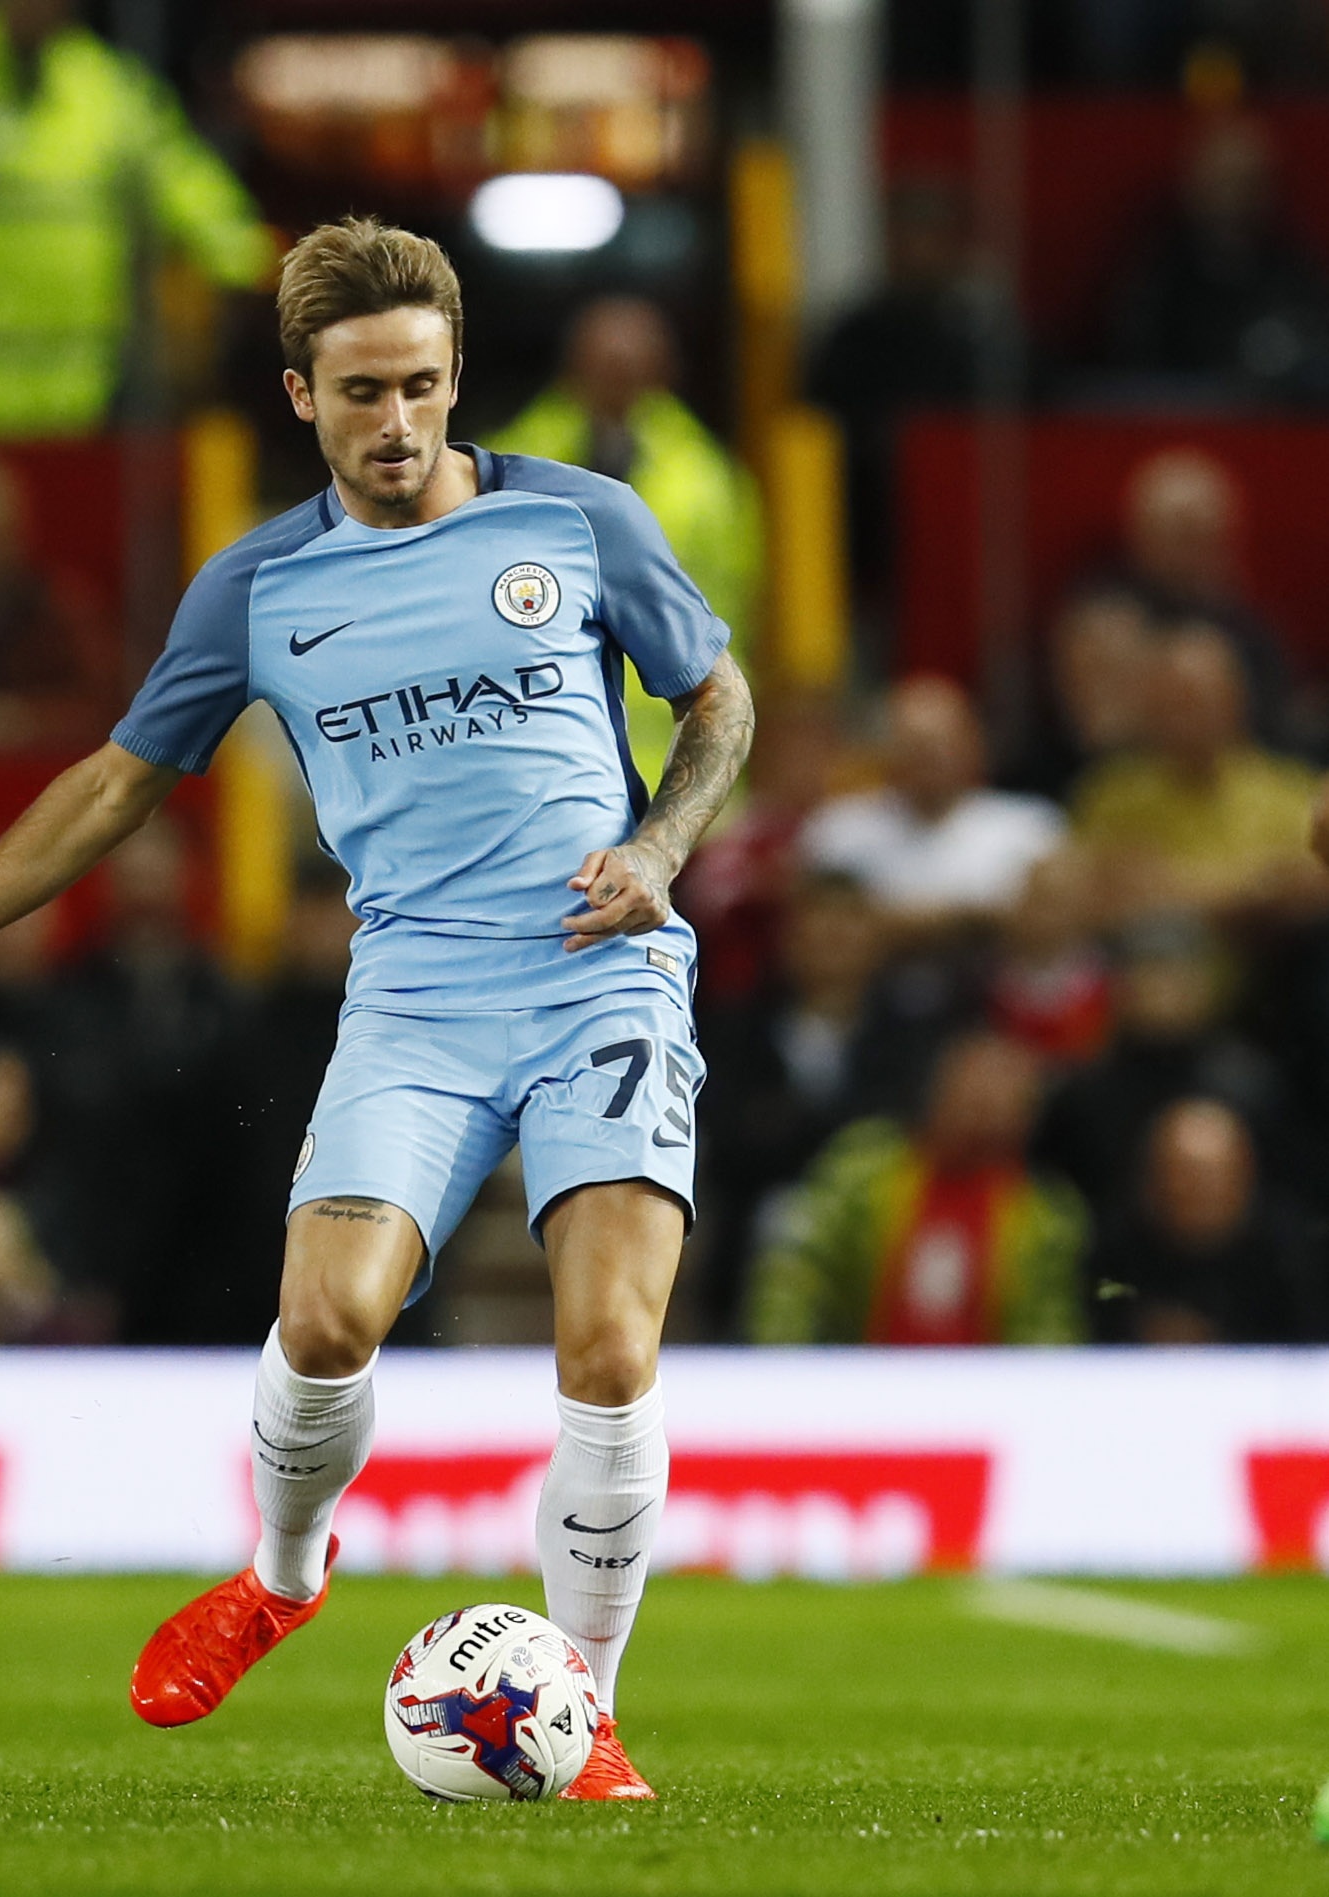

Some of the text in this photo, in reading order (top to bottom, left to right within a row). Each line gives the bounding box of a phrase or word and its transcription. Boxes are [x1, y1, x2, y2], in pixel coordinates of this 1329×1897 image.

[498, 567, 552, 590] MANCHESTER
[315, 662, 563, 743] ETIHAD
[371, 705, 528, 762] AIRWAYS
[590, 1039, 690, 1141] 75
[449, 1611, 527, 1672] mitre
[526, 1664, 543, 1679] EFL
